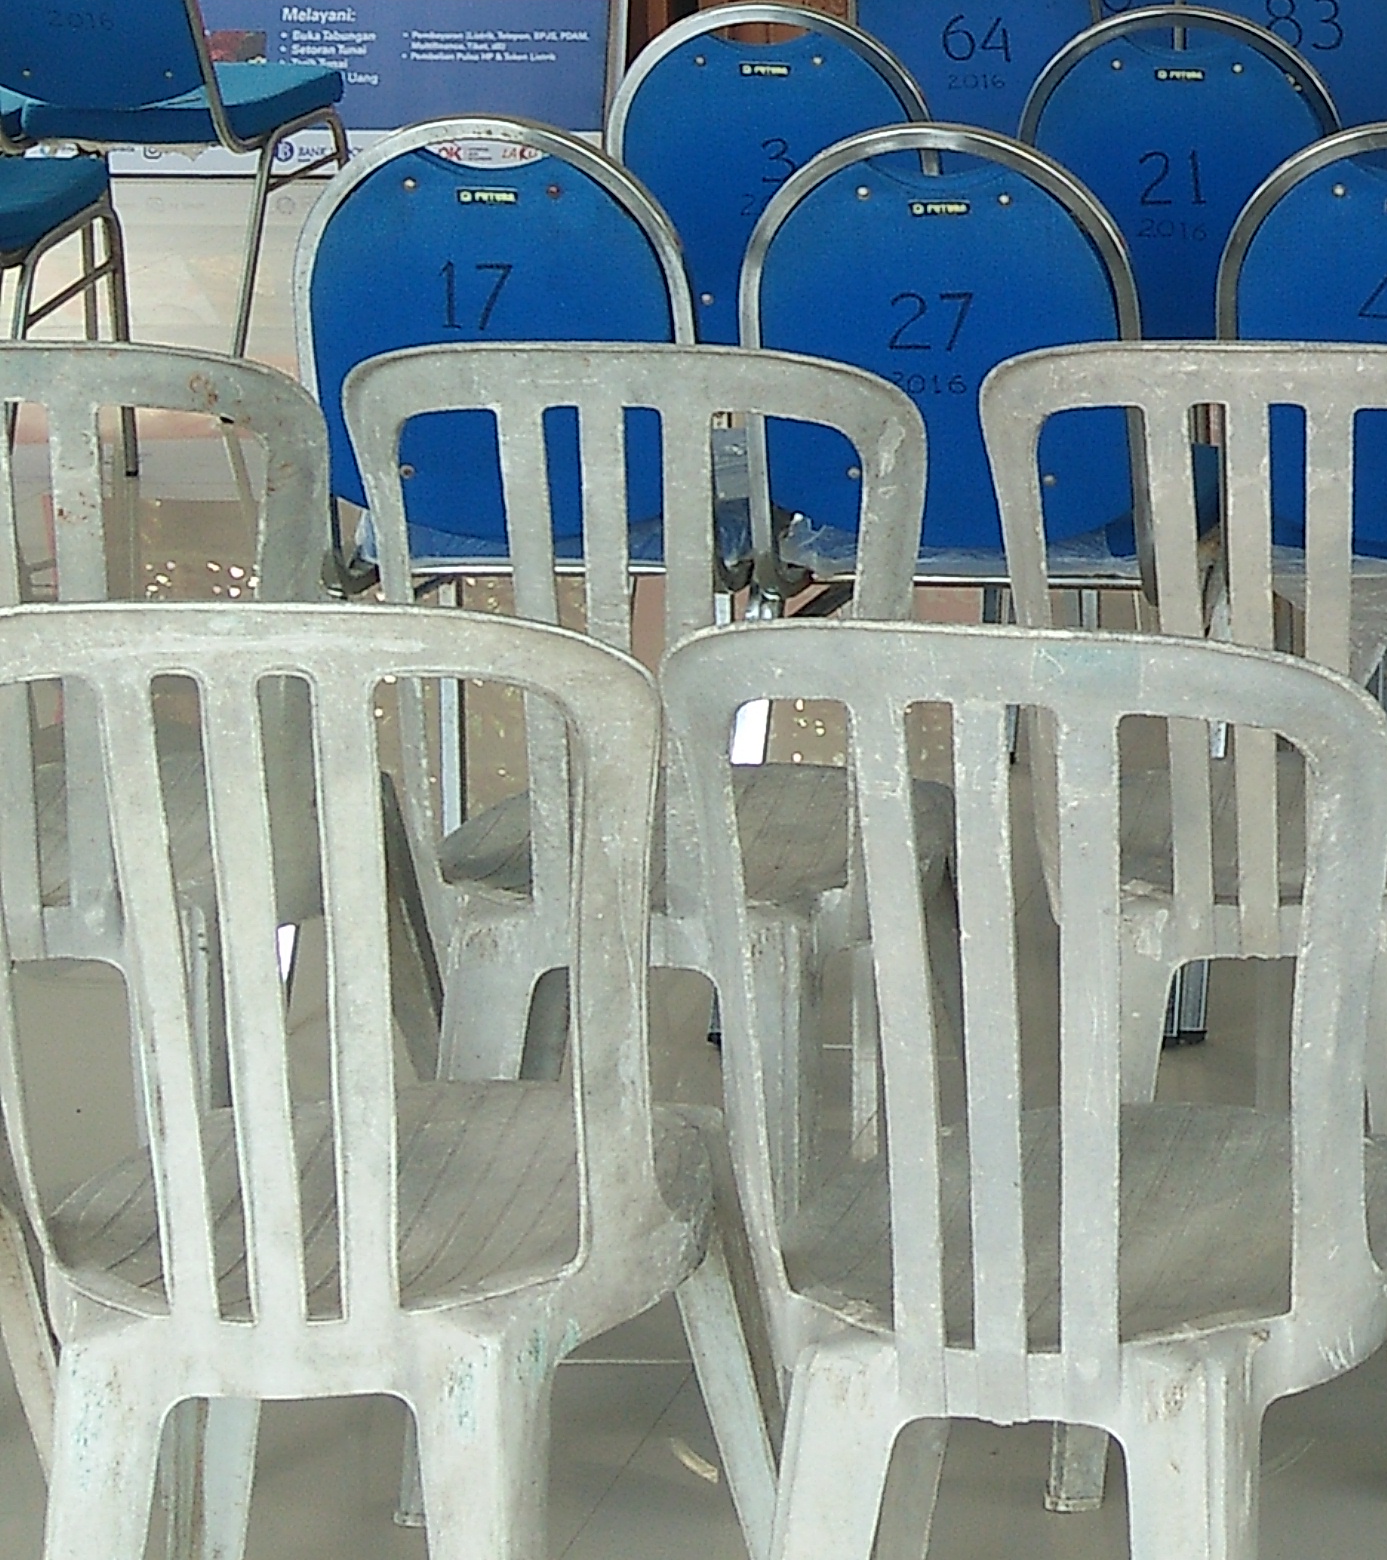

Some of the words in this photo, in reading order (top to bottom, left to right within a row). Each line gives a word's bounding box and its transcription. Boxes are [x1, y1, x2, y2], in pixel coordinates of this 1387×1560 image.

[282, 6, 357, 25] Melayani:
[942, 14, 1012, 63] 64
[948, 74, 1006, 90] 2016
[1138, 149, 1207, 206] 21
[1137, 218, 1208, 240] 2016
[438, 260, 514, 332] 17
[887, 291, 974, 353] 27
[891, 371, 968, 395] 2016
